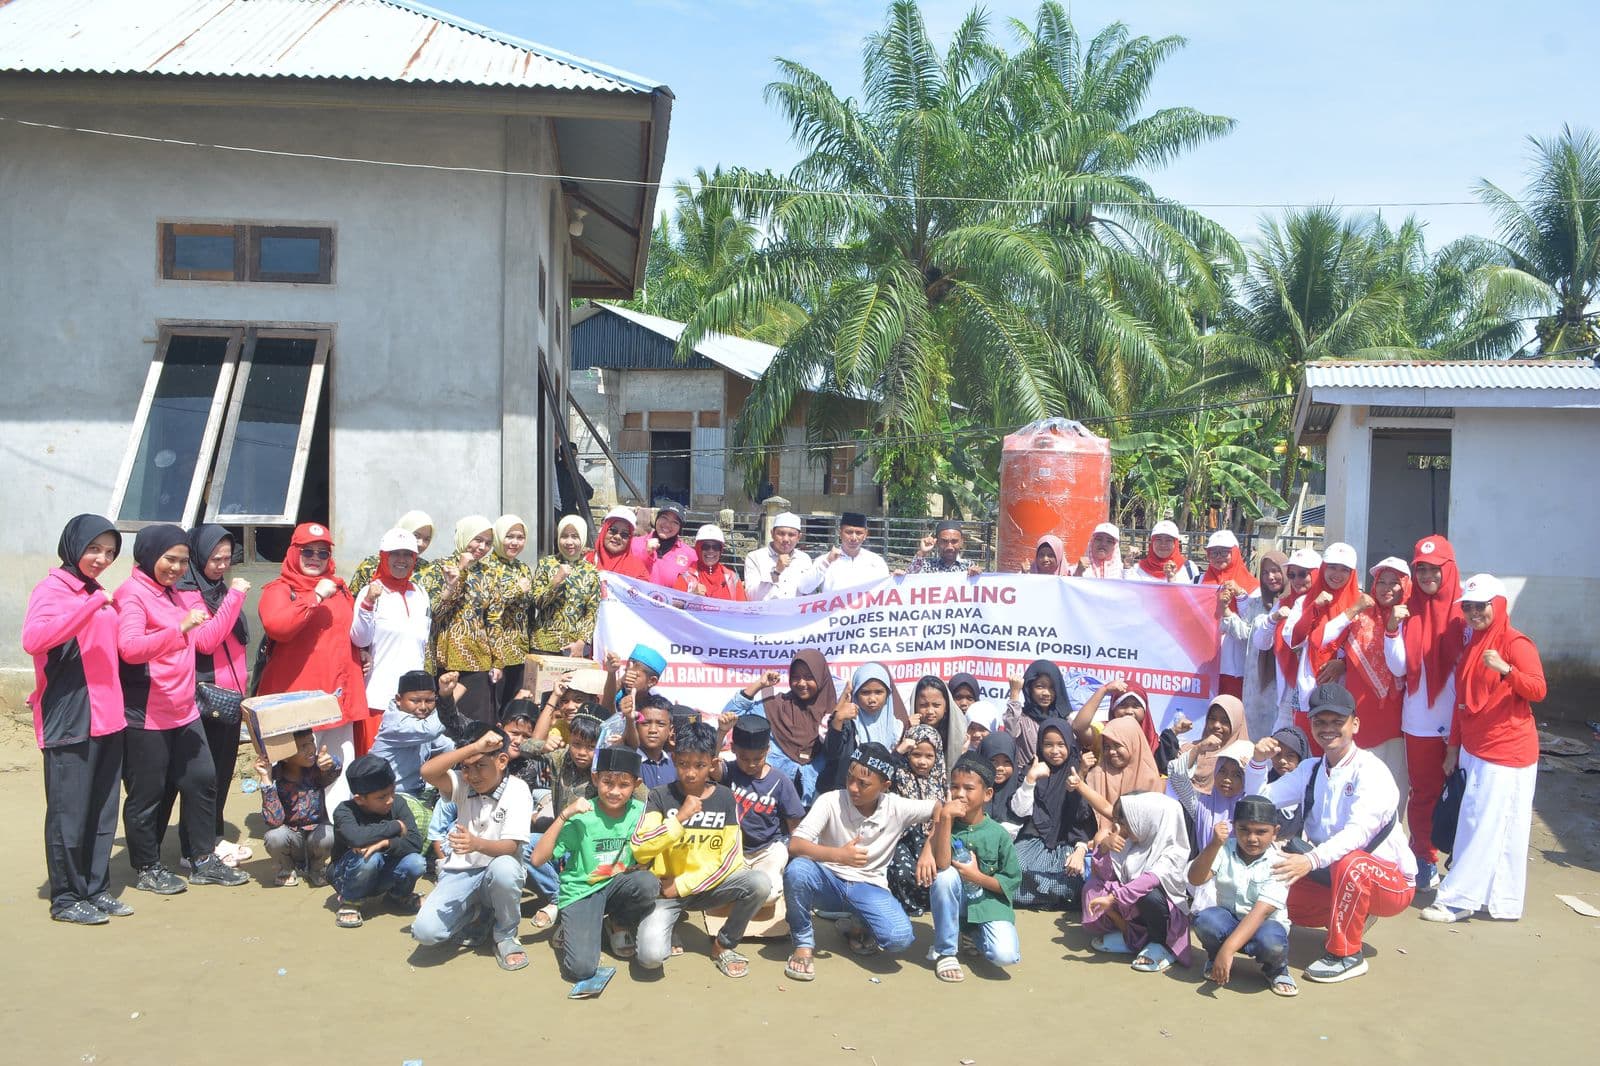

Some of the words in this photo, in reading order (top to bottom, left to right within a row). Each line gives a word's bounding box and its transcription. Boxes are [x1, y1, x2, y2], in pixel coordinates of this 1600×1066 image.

[799, 588, 903, 614] TRAUMA
[910, 585, 1017, 605] HEALING
[829, 611, 884, 627] POLRES
[889, 609, 941, 621] NAGAN
[945, 607, 982, 619] RAYA
[798, 628, 865, 644] JANTUNG
[869, 625, 918, 638] SEHAT
[922, 623, 956, 638] (KJS)
[960, 623, 1012, 636] NAGAN
[1017, 625, 1058, 638] RAYA
[670, 643, 704, 656] DPD
[708, 647, 799, 659] PERSATUAN
[849, 642, 892, 654] RAGA
[896, 639, 945, 652] SENAM
[951, 638, 1031, 652] INDONESIA
[1035, 641, 1092, 658] (PORSI)
[1095, 646, 1138, 660] ACEH
[677, 666, 724, 684] BANTU
[888, 663, 940, 679] KORBAN
[943, 660, 1003, 678] BENCANA
[667, 808, 726, 828] SPER
